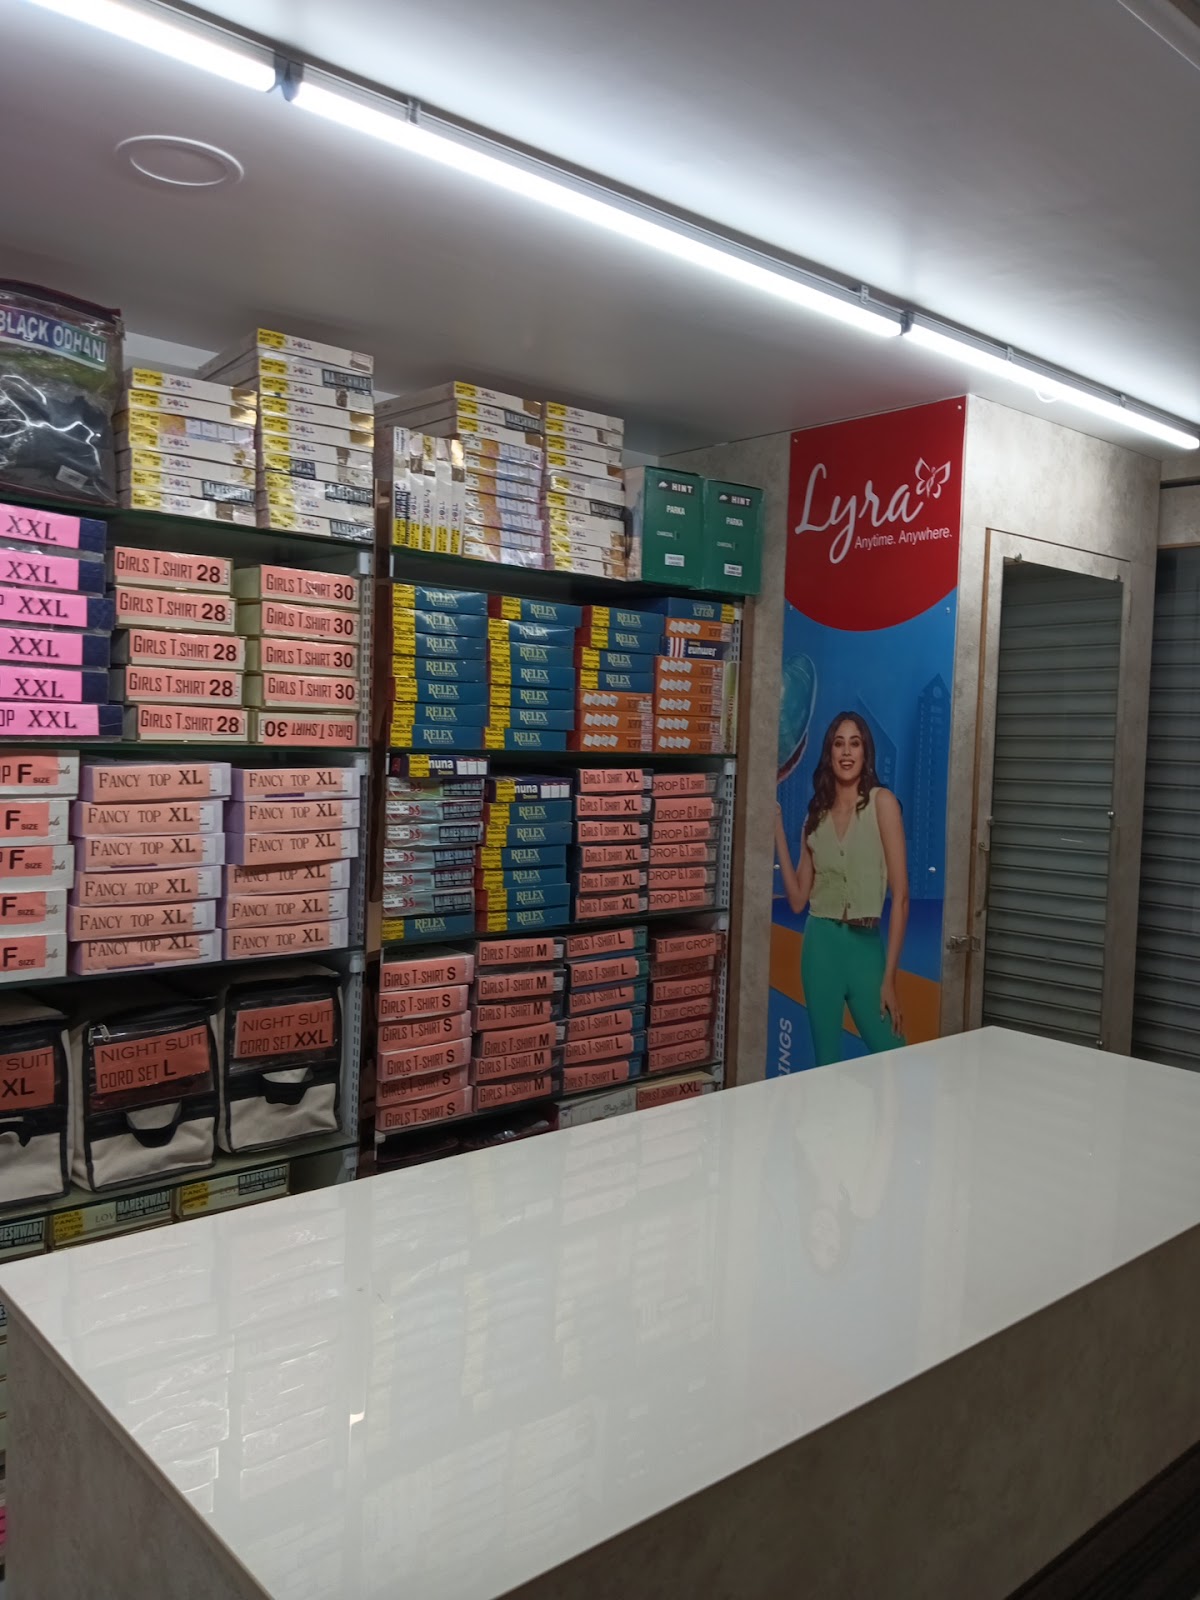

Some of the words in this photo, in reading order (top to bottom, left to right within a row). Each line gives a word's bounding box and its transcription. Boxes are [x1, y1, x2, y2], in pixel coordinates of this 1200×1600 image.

[0, 310, 49, 342] BLACK
[53, 325, 107, 362] ODHANI
[672, 483, 693, 493] HINT
[731, 496, 751, 505] HINT
[794, 462, 924, 564] Lyra
[6, 515, 57, 541] XXL
[854, 534, 896, 551] Anytime.
[898, 527, 953, 546] Anywhere.
[6, 560, 57, 584] XXL
[117, 552, 149, 573] GIRLS
[197, 564, 220, 583] 28
[266, 574, 294, 593] GIRLS
[334, 583, 353, 600] 30
[17, 596, 68, 618] XXL
[120, 593, 153, 613] GIRLS
[202, 603, 225, 621] 28
[530, 604, 557, 619] RELEX
[267, 608, 294, 627] GIRLS
[334, 618, 353, 635] 30
[617, 613, 641, 627] RELEX
[9, 636, 59, 658] XXL
[134, 636, 166, 655] GIRLS
[214, 644, 236, 661] 28
[427, 637, 457, 652] RELEX
[520, 645, 548, 661] RELEX
[266, 647, 294, 664] GIRLS
[334, 652, 353, 668] 30
[426, 661, 457, 676] RELEX
[521, 668, 549, 682] RELEX
[14, 678, 64, 698] XXL
[129, 673, 161, 692] GIRLS
[209, 680, 233, 697] 28
[269, 678, 296, 695] GIRLS
[335, 684, 354, 700] 30
[428, 684, 458, 699] RELEX
[521, 690, 549, 704] RELEX
[28, 709, 78, 729] XXL
[141, 710, 172, 729] GIRLS
[217, 717, 239, 732] 28
[426, 706, 457, 721] RELEX
[520, 711, 548, 725] RELEX
[265, 721, 287, 737] 30
[328, 724, 353, 740] GIRLS
[423, 729, 453, 744] RELEX
[514, 732, 541, 746] RELEX
[17, 764, 33, 783] F
[99, 772, 140, 788] FANCY
[148, 774, 171, 787] TOP
[178, 770, 203, 785] XL
[249, 773, 284, 787] FANCY
[291, 775, 310, 787] TOP
[316, 772, 337, 785] XL
[626, 772, 639, 782] XL
[88, 808, 130, 823] FANCY
[138, 809, 161, 823] TOP
[168, 807, 194, 822] XL
[249, 805, 284, 820] FANCY
[291, 807, 310, 818] TOP
[316, 804, 337, 817] XL
[624, 800, 637, 811] XL
[657, 810, 685, 819] DROP
[5, 810, 21, 830] F
[249, 838, 283, 852] FANCY
[290, 838, 309, 850] TOP
[315, 834, 336, 847] XL
[654, 829, 682, 839] DROP
[91, 840, 133, 856] FANCY
[140, 842, 163, 855] TOP
[171, 838, 195, 853] XL
[9, 850, 25, 870] F
[85, 881, 127, 897] FANCY
[135, 882, 159, 895] TOP
[166, 879, 192, 894] XL
[1, 897, 17, 916] F
[80, 915, 122, 930] FANCY
[131, 914, 154, 927] TOP
[161, 910, 187, 925] XL
[618, 933, 625, 944] L
[3, 947, 18, 967] F
[481, 946, 503, 961] GIRLS
[506, 945, 534, 959] T-SHIRT
[537, 944, 547, 956] M
[384, 971, 410, 987] GIRLS
[412, 969, 444, 984] T-SHIRT
[447, 967, 456, 980] S
[621, 964, 628, 975] L
[481, 979, 503, 995] GIRLS
[506, 978, 534, 992] T-SHIRT
[537, 977, 547, 989] M
[381, 998, 406, 1014] GIRLS
[409, 997, 439, 1012] T-SHIRT
[442, 994, 450, 1008] S
[242, 1015, 294, 1033] NIGHT
[298, 1009, 333, 1025] SUIT
[383, 1026, 407, 1042] GIRLS
[410, 1021, 441, 1039] T-SHIRT
[443, 1018, 452, 1032] S
[100, 1041, 161, 1063] NIGHT
[165, 1032, 205, 1050] SUIT
[273, 1035, 292, 1050] SET
[294, 1029, 328, 1047] XXL
[779, 1018, 793, 1076] INGS
[6, 1052, 51, 1071] SUIT
[100, 1068, 134, 1089] CORD
[138, 1064, 159, 1083] SET
[163, 1059, 177, 1077] L
[1, 1078, 35, 1097] XL
[679, 1082, 700, 1095] XXL
